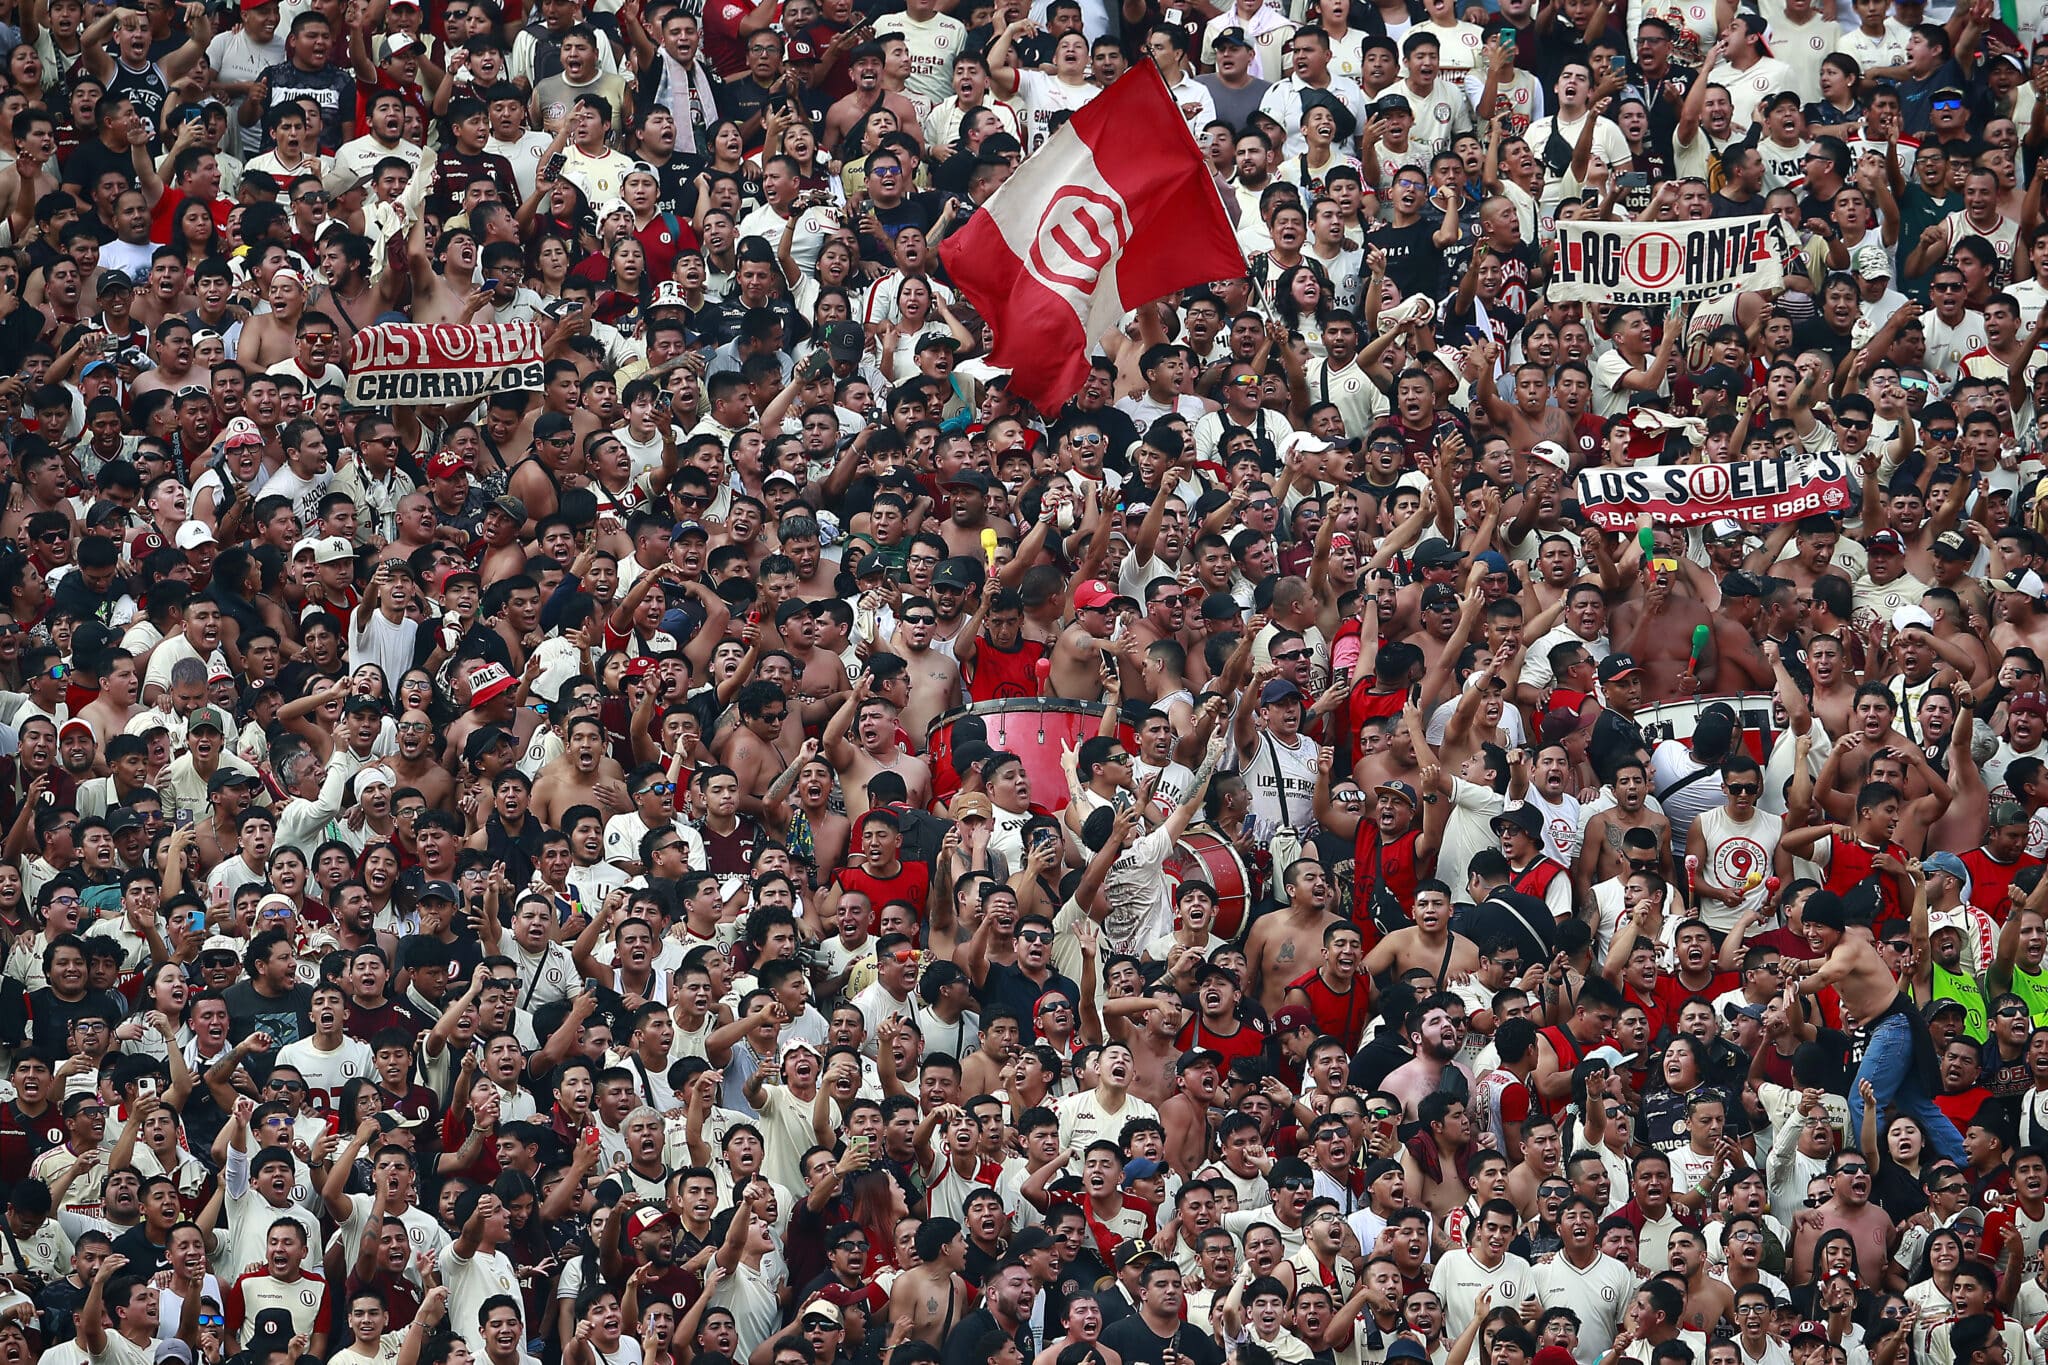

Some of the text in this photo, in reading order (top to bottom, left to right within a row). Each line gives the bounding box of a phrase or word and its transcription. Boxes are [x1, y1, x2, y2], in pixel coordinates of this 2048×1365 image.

[910, 55, 945, 67] uesta
[910, 65, 933, 77] otal
[1582, 220, 1762, 288] AGUANTE
[1613, 282, 1733, 304] BARRANCO
[1970, 338, 1978, 349] U
[356, 360, 544, 400] CHORRILLOS
[1348, 380, 1356, 390] U
[1583, 436, 1591, 447] U
[1579, 472, 1651, 507] LOS
[1664, 451, 1842, 504] SUELTS
[625, 495, 634, 506] U
[1609, 512, 1689, 527] BARA
[1692, 505, 1766, 523] NORTE
[1773, 493, 1820, 518] 1988
[1843, 556, 1852, 567] U
[1888, 595, 1897, 605] U
[849, 667, 858, 679] U
[474, 671, 496, 689] DALE
[1257, 774, 1277, 788] LOS
[1719, 841, 1739, 859] BANDA
[1750, 845, 1764, 867] NORTE
[1731, 850, 1752, 878] 9
[1734, 880, 1747, 888] 197
[550, 971, 558, 981] U
[344, 1064, 353, 1076] U
[1999, 1065, 2028, 1084] UEL
[51, 1131, 59, 1142] U
[294, 1187, 302, 1198] U
[413, 1230, 420, 1241] U
[1134, 1241, 1146, 1255] P
[520, 1277, 532, 1289] al
[1504, 1284, 1512, 1296] U
[1604, 1289, 1611, 1300] U
[304, 1293, 312, 1304] U
[675, 1294, 683, 1306] U
